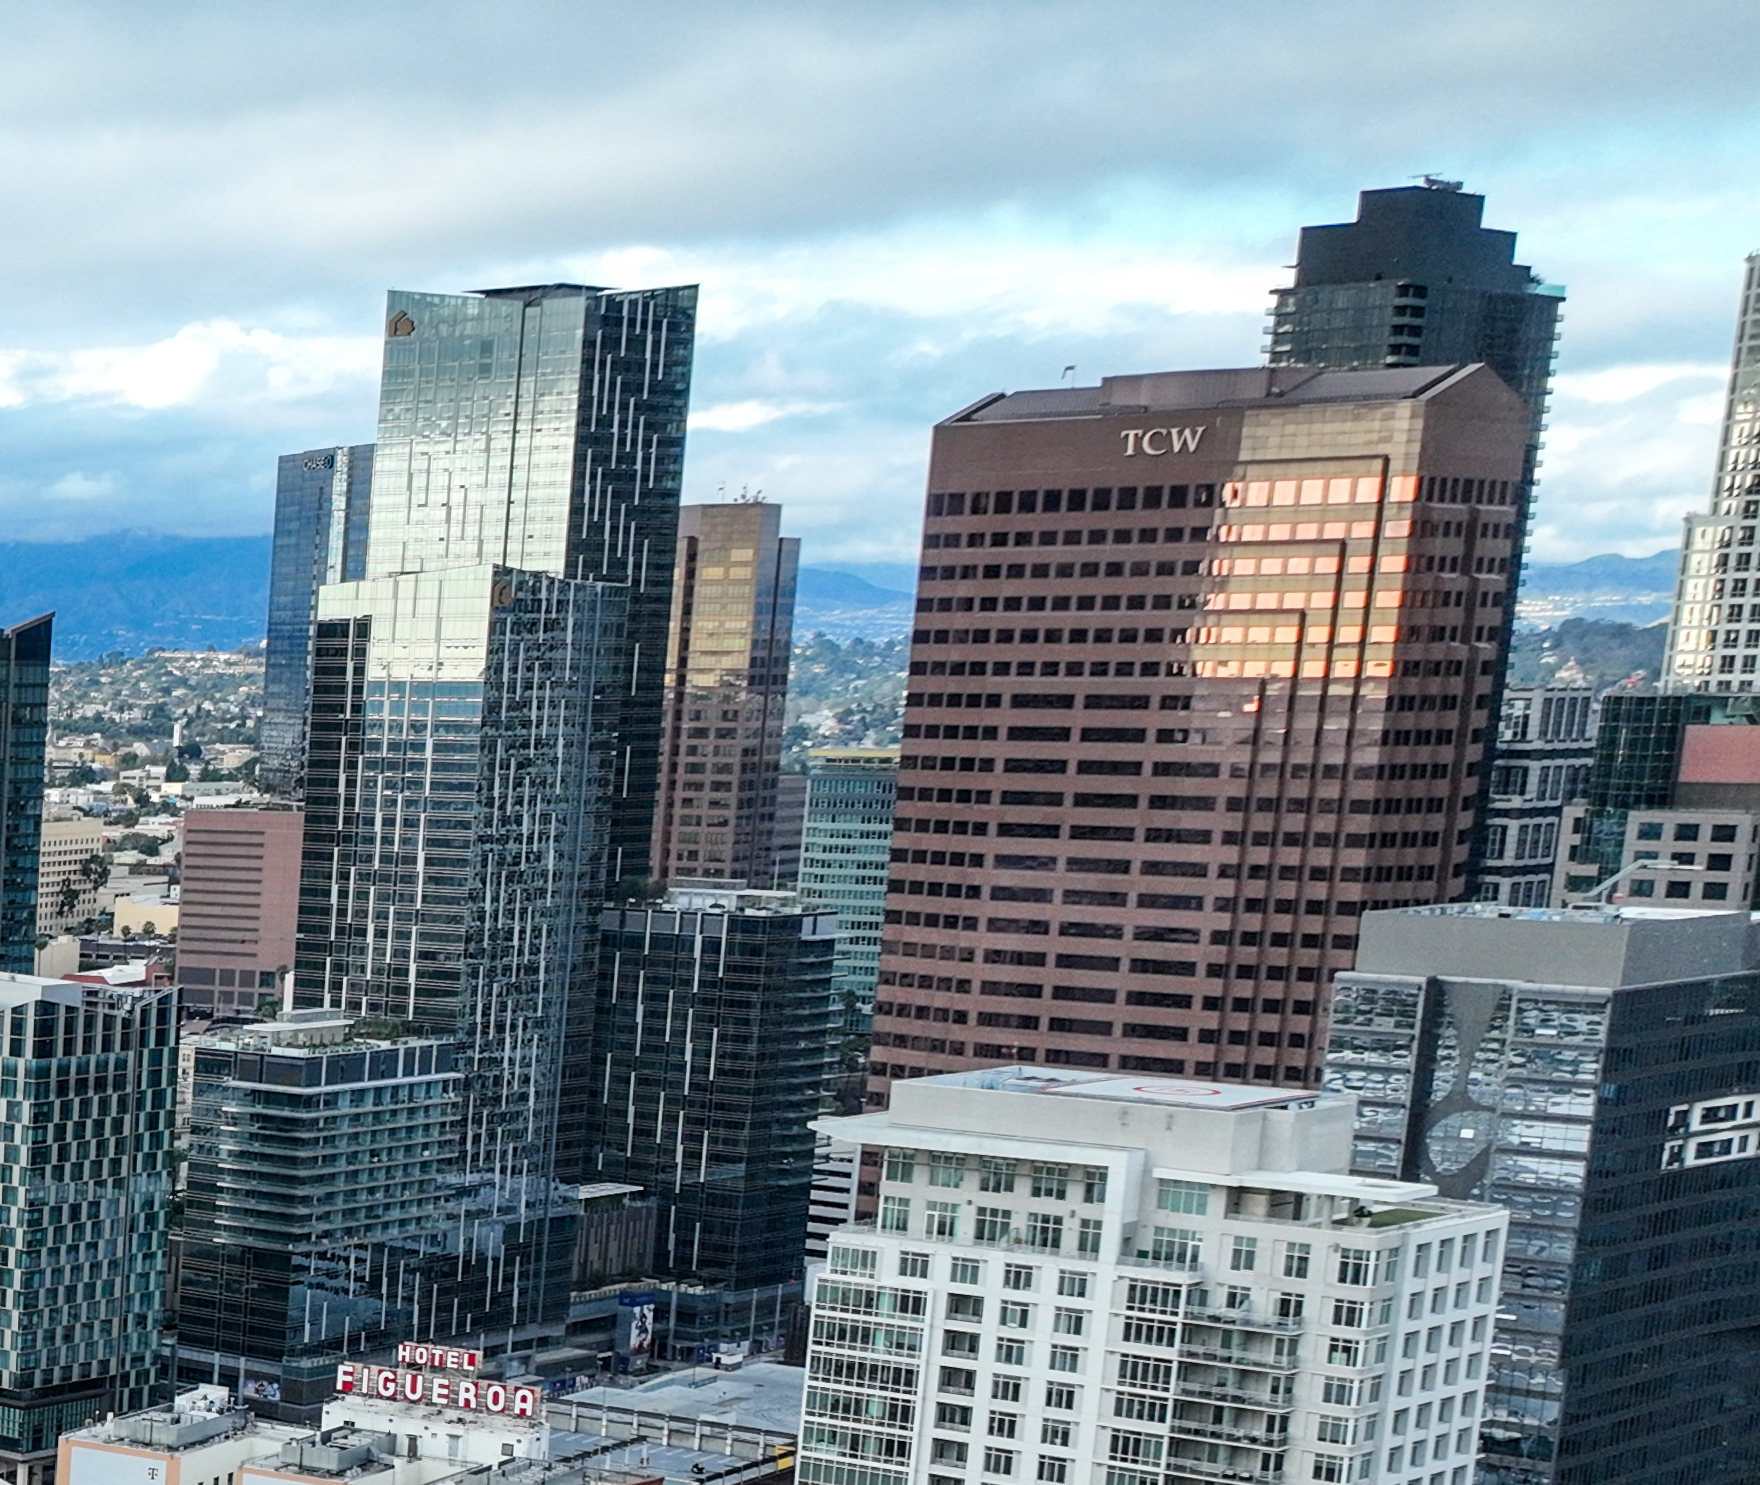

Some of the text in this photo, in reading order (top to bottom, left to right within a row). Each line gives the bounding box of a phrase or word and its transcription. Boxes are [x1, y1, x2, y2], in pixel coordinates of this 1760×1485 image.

[1120, 425, 1206, 456] TCW
[398, 1343, 476, 1371] HOTEL
[336, 1364, 534, 1417] FIGUEROA
